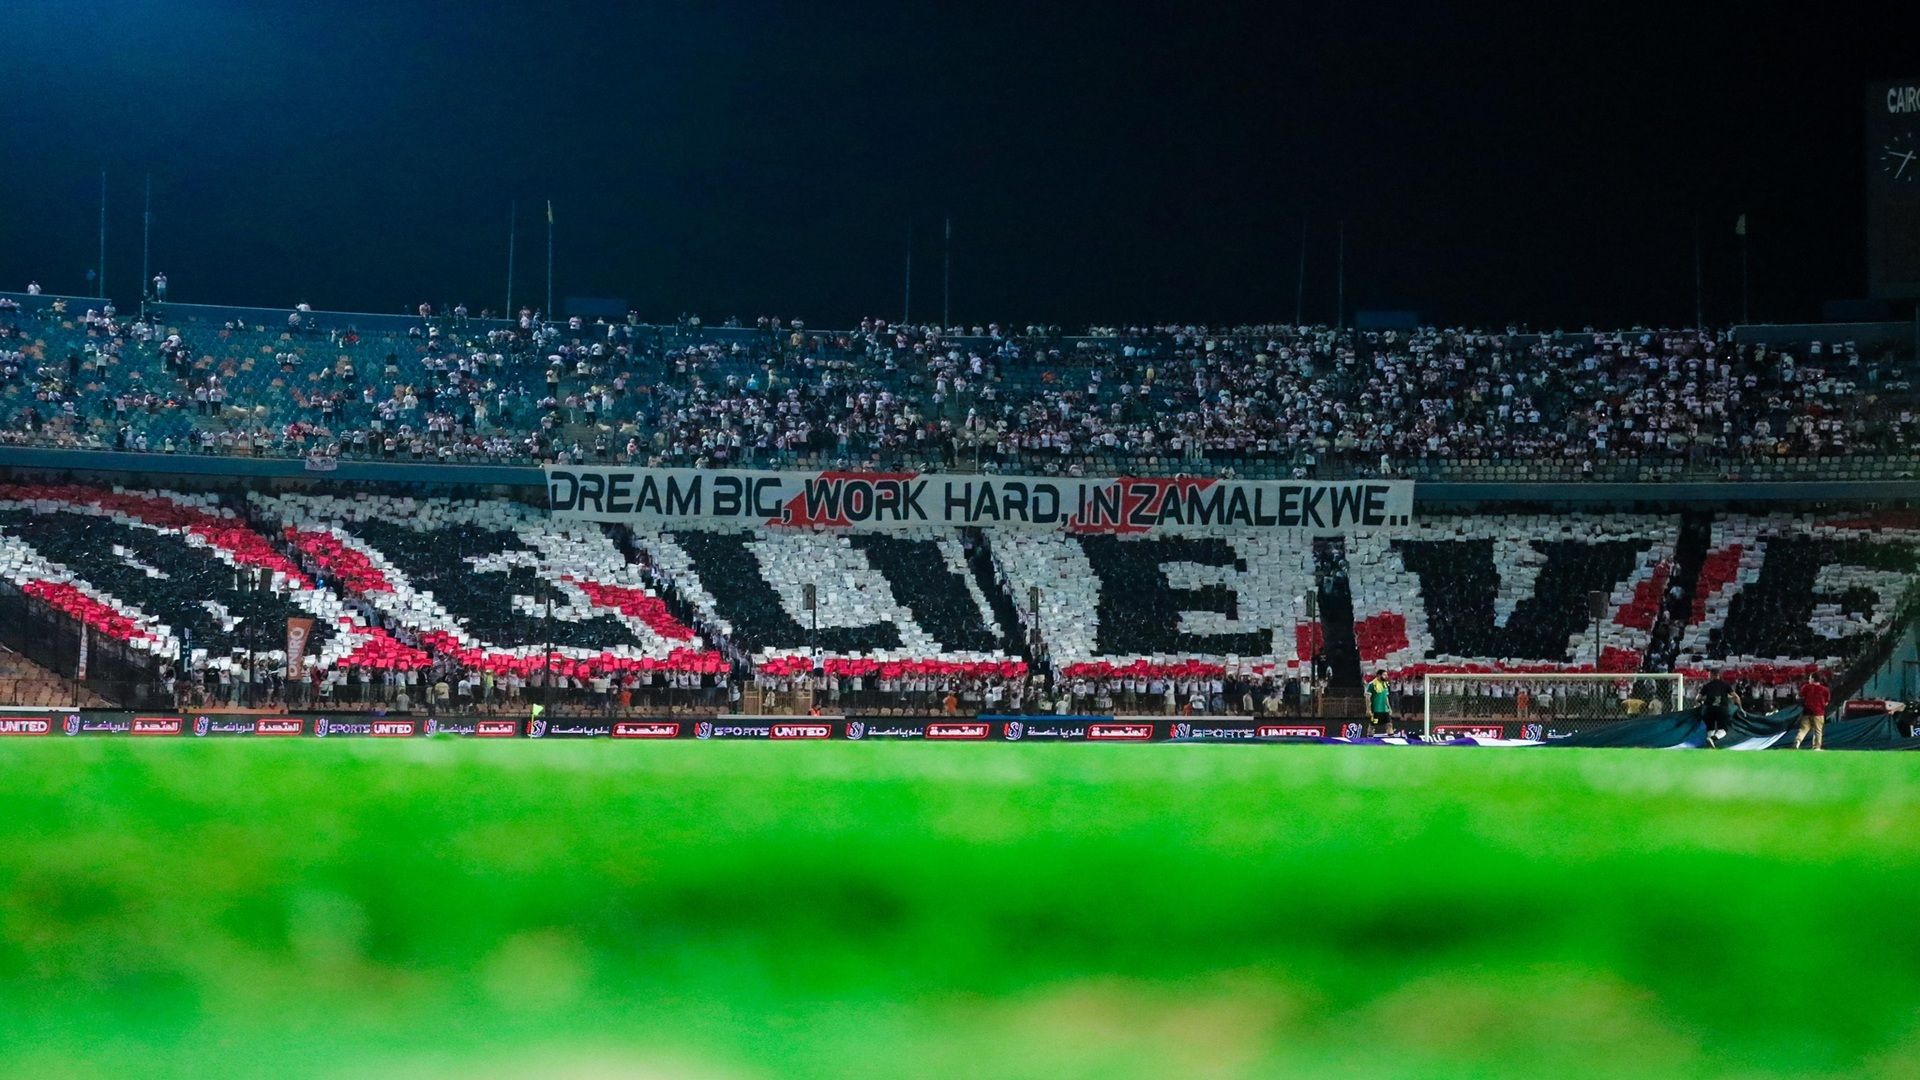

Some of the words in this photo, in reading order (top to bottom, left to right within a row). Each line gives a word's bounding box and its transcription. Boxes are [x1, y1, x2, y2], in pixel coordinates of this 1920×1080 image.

[550, 470, 700, 516] DREAM
[713, 475, 791, 525] BIG,
[805, 477, 928, 523] WORK
[945, 480, 1069, 527] HARD,
[1078, 484, 1121, 526] IN
[1128, 483, 1328, 528] ZAMALEK
[0, 720, 48, 732] UNITED
[329, 723, 371, 735] SPORTS
[374, 722, 412, 735] UNITED
[713, 726, 770, 737] SPORTS
[774, 725, 828, 737] UNITED
[1192, 728, 1255, 738] SPORTS
